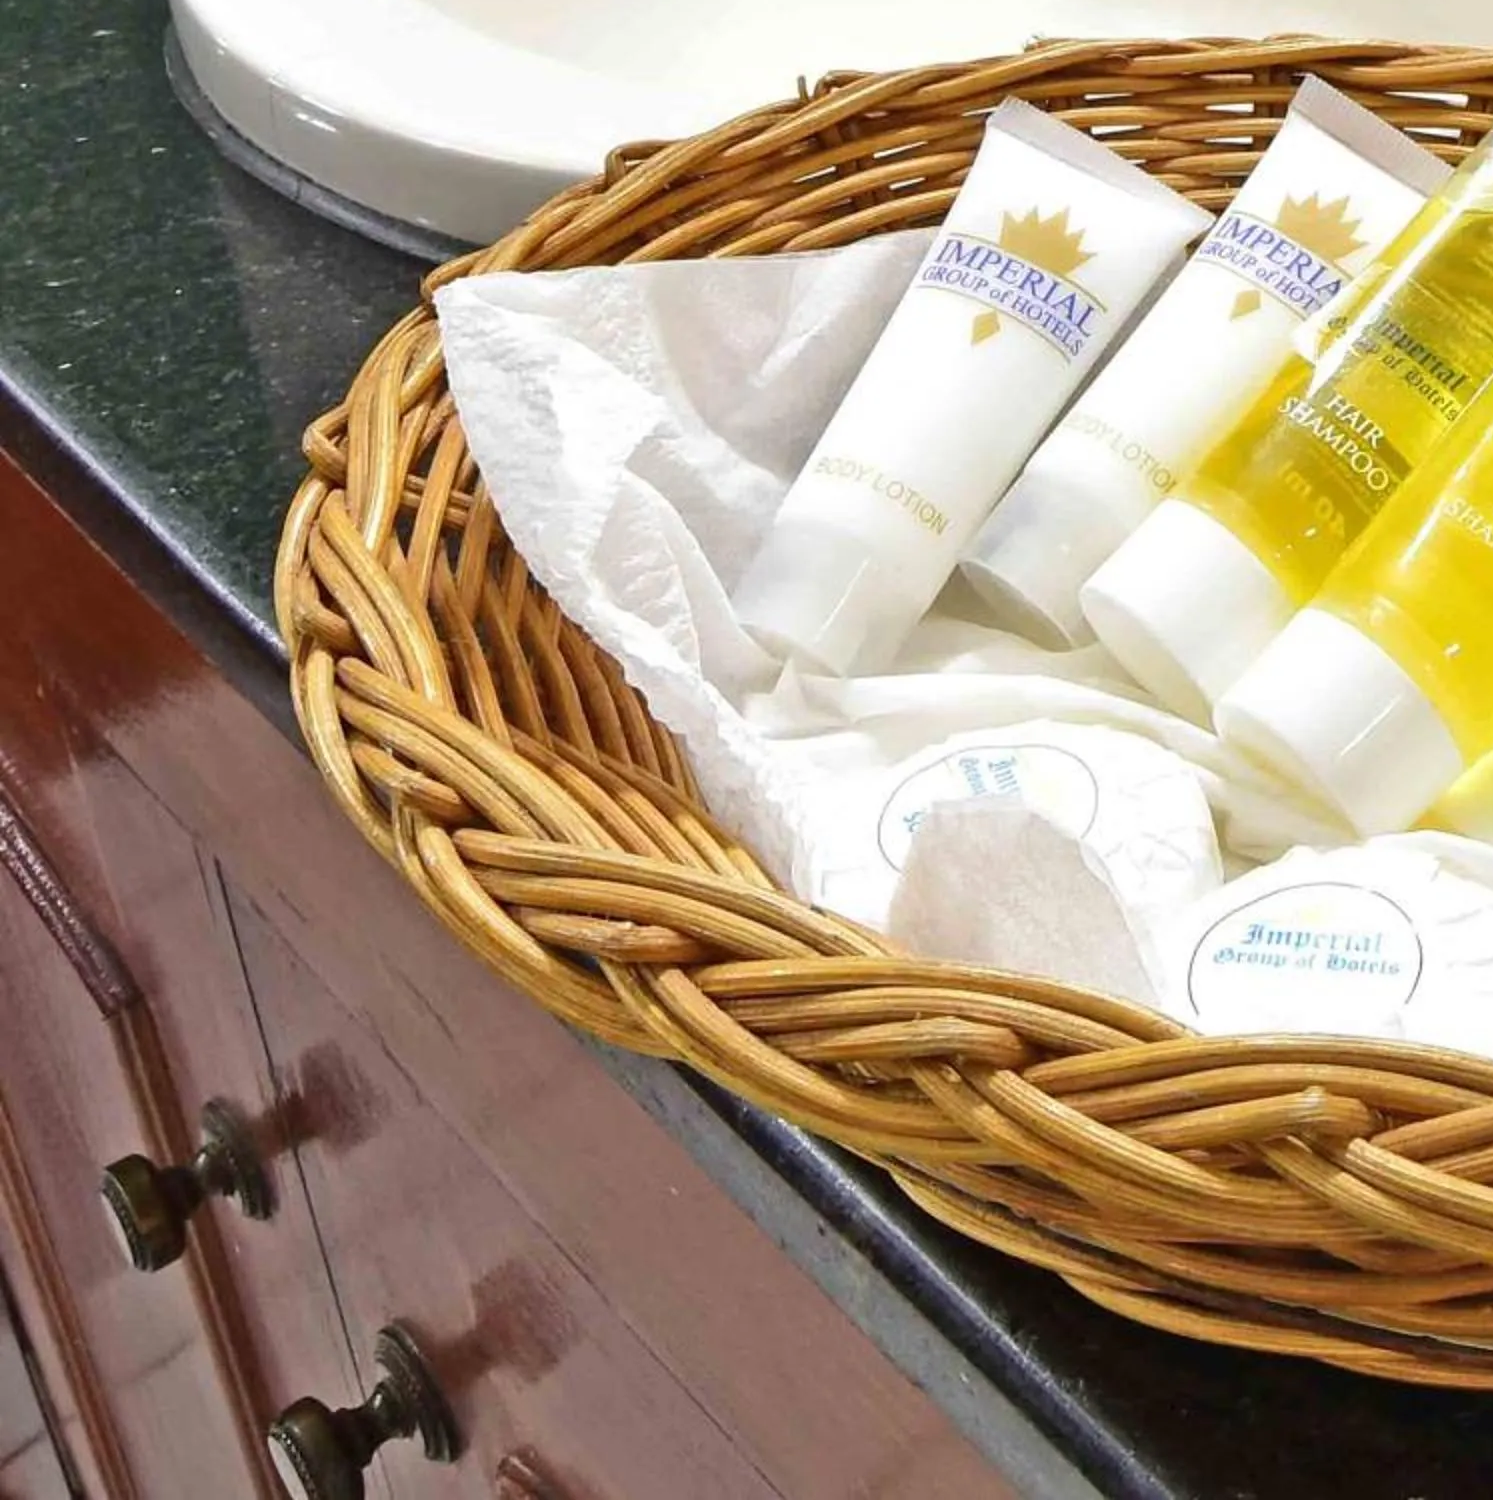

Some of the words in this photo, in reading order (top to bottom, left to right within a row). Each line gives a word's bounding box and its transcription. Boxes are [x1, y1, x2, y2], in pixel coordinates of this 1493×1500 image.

[934, 239, 1096, 338] IMPERIAL
[1214, 216, 1342, 297] IMPERIA
[921, 265, 990, 293] GROUP
[989, 287, 1013, 304] of
[1010, 294, 1085, 357] HOTELS
[1274, 275, 1323, 311] HOT
[1277, 395, 1389, 491] SHAMPOO
[1324, 393, 1385, 450] HAIR
[1109, 431, 1177, 495] LOTIO
[871, 472, 951, 536] LOTION
[1240, 923, 1383, 954] Imperial
